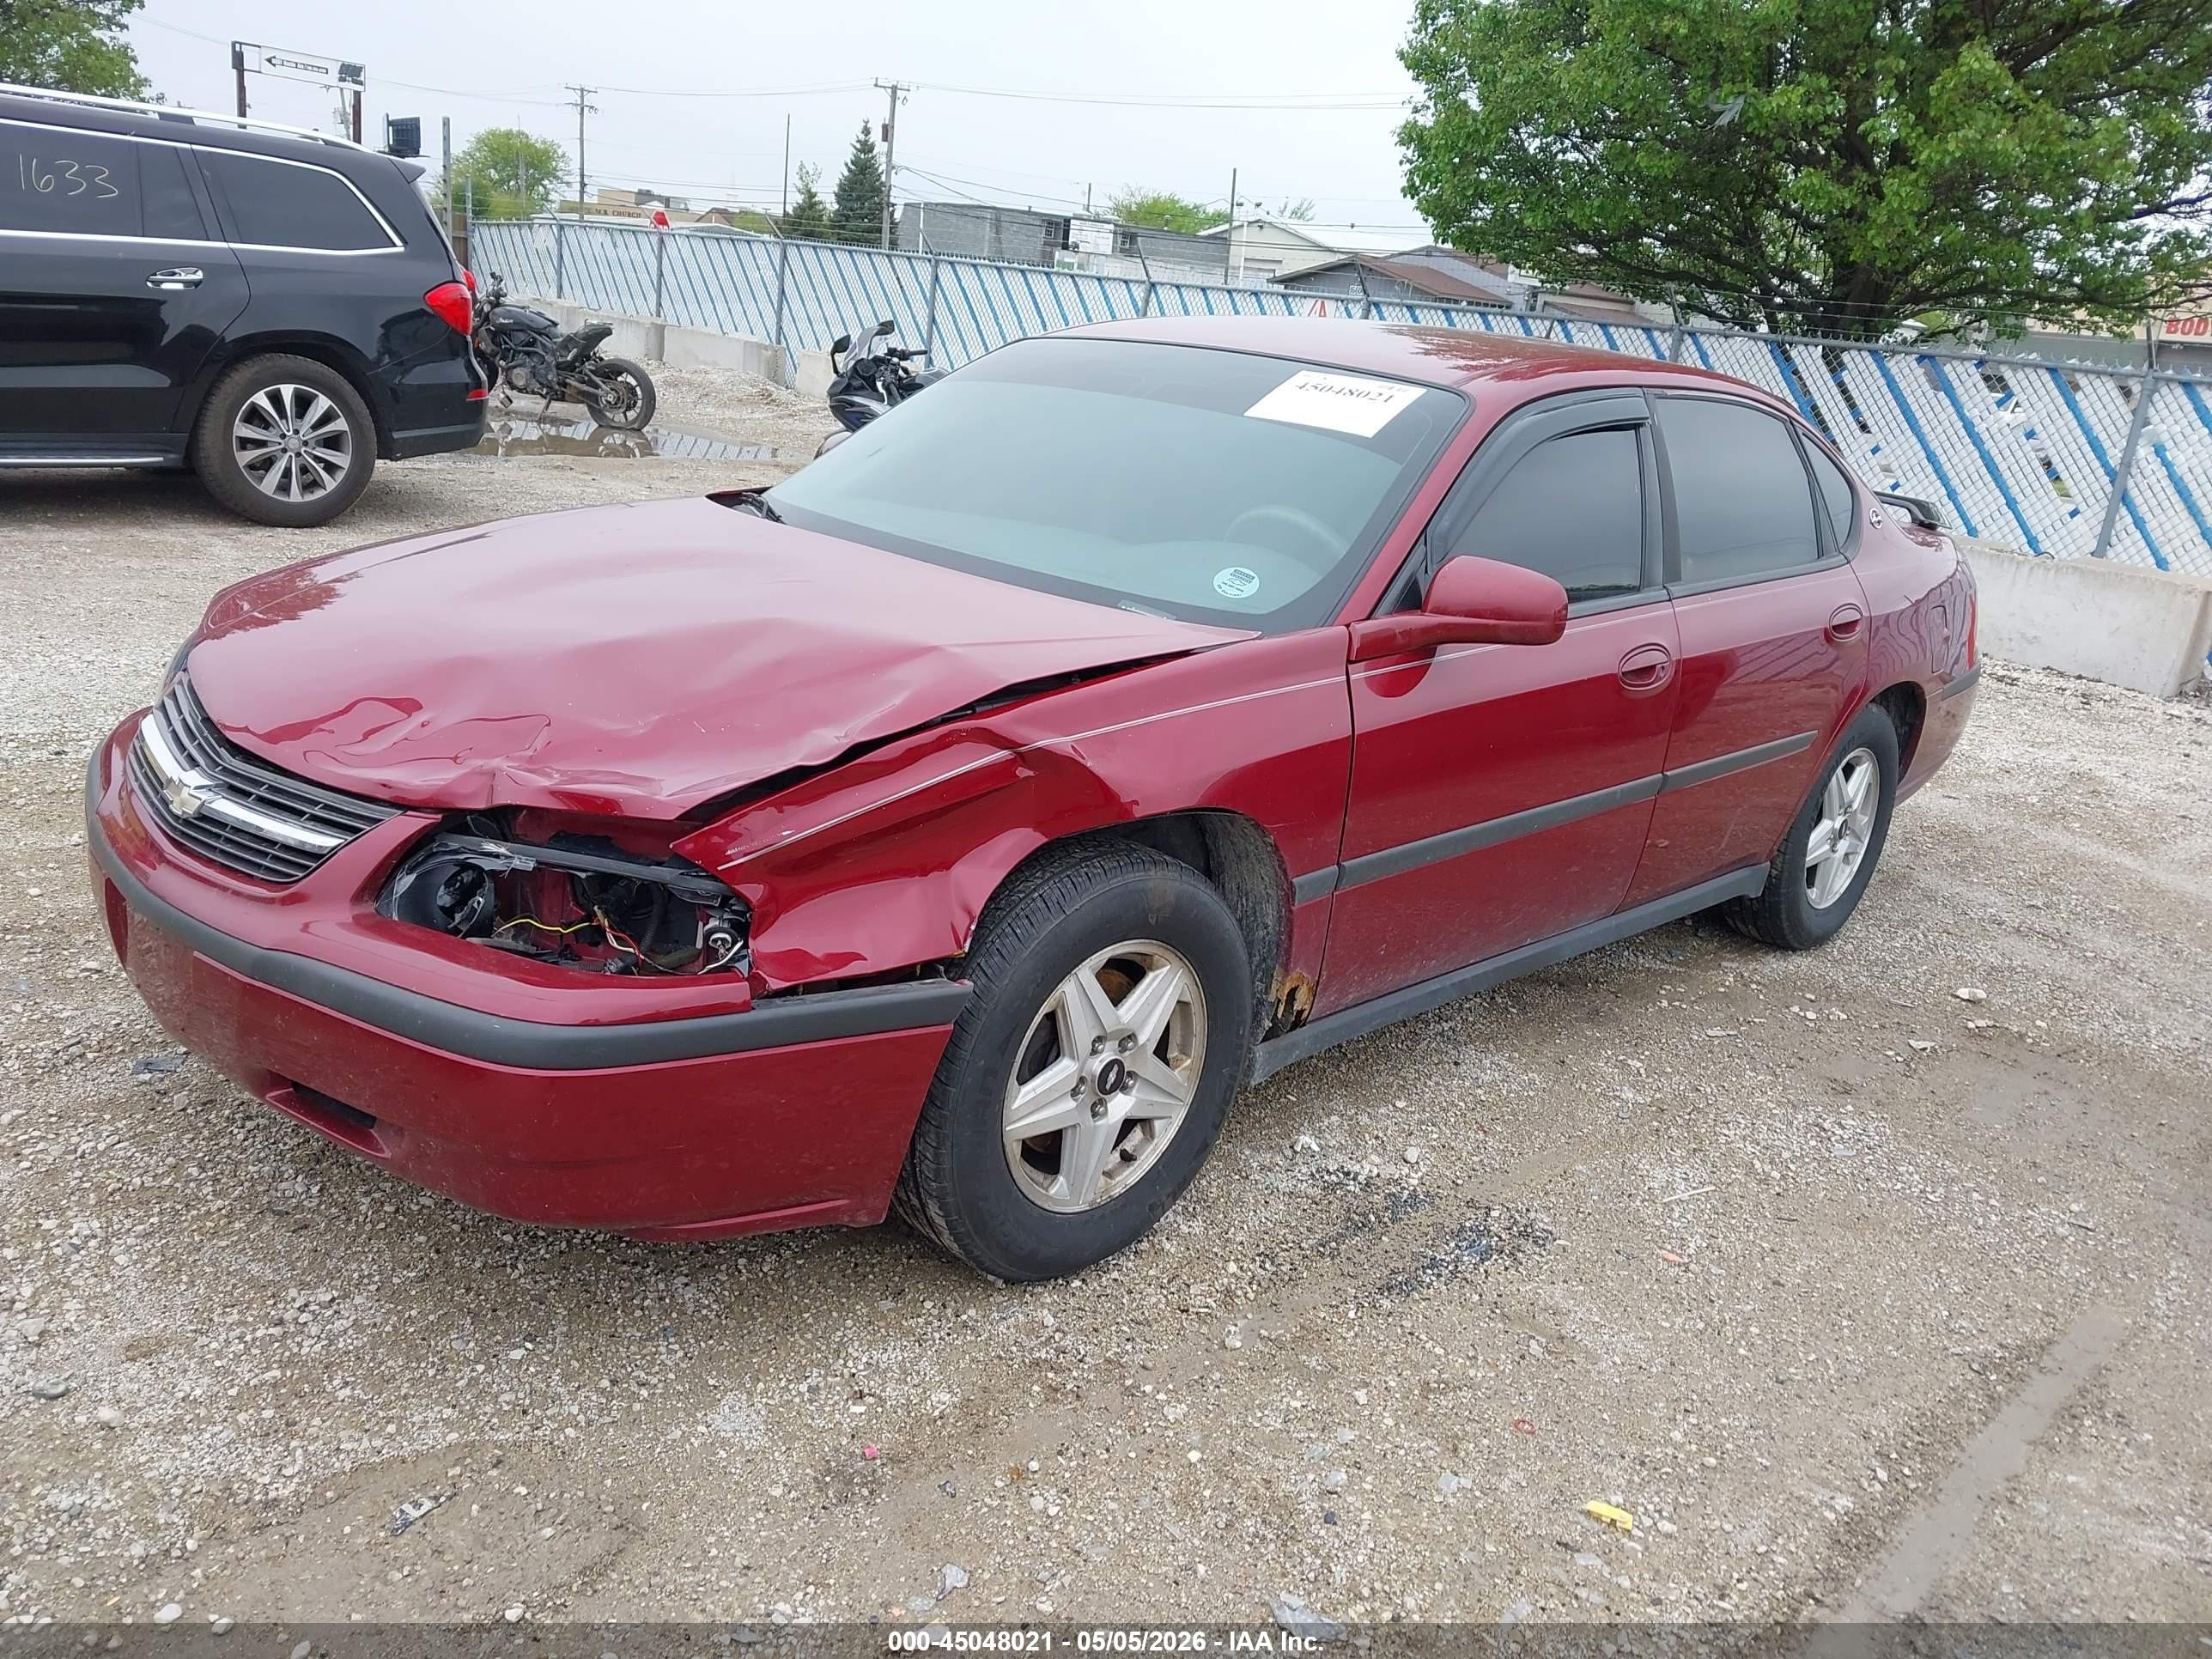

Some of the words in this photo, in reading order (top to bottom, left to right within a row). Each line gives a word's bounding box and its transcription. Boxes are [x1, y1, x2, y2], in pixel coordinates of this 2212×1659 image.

[19, 153, 119, 198] 1633
[611, 210, 641, 219] CHURCH
[2165, 315, 2212, 337] BOD
[1295, 381, 1395, 404] 45048021
